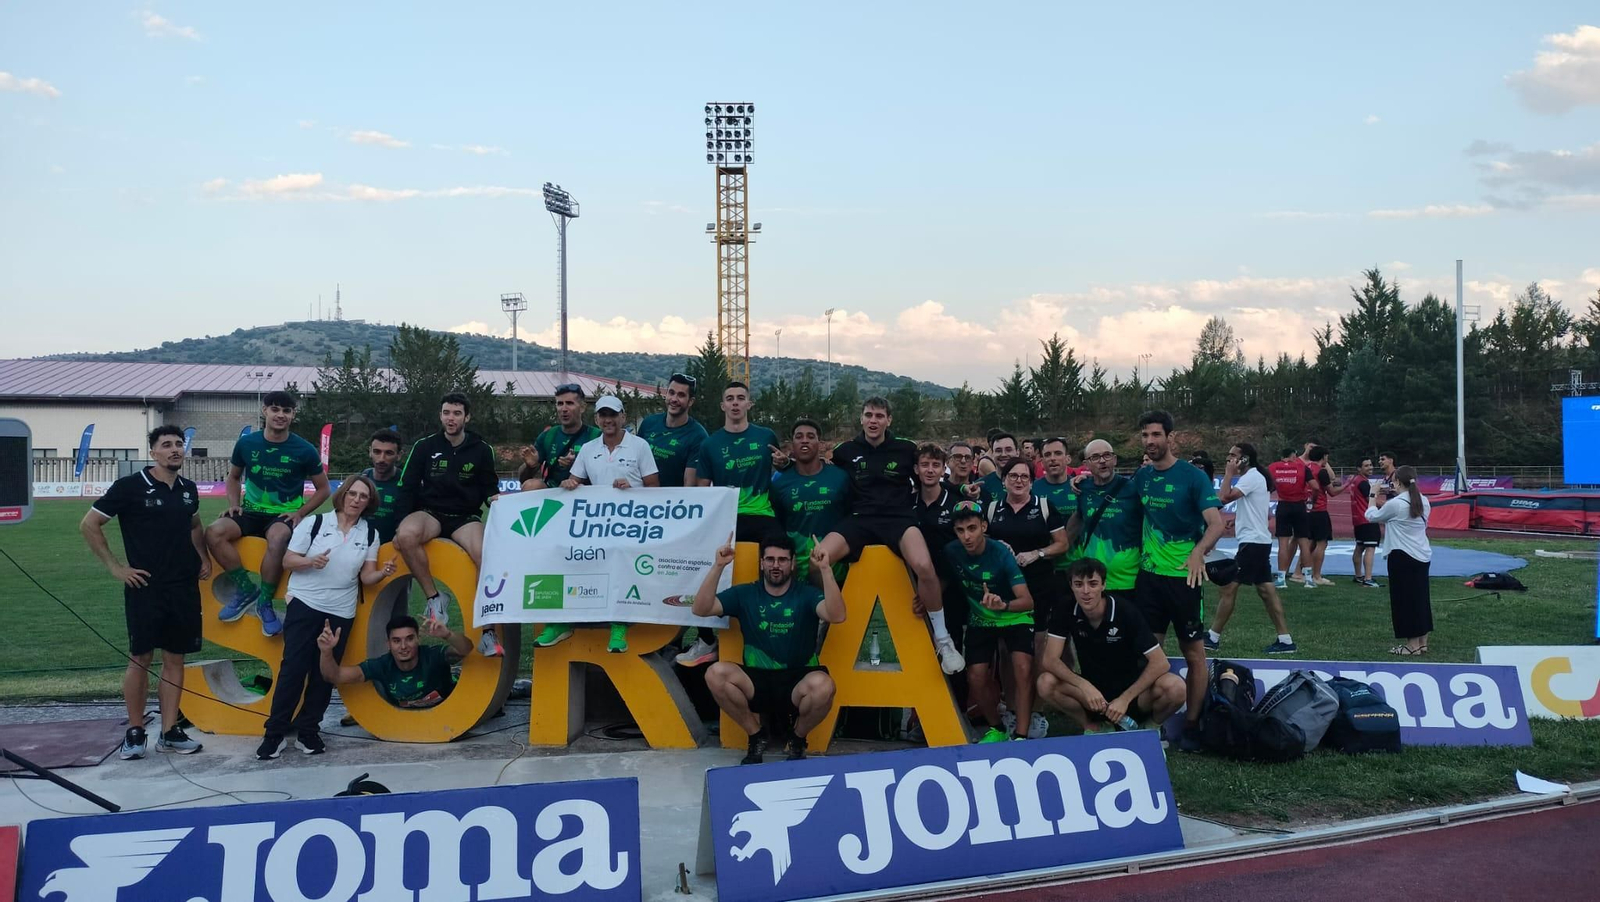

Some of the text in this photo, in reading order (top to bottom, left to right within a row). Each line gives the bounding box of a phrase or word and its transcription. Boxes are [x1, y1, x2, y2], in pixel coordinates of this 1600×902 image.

[571, 498, 704, 520] Fundación
[568, 518, 664, 544] Unicaja
[564, 545, 606, 561] Jaén
[658, 557, 688, 565] asociación
[578, 586, 599, 596] Jaén
[481, 601, 504, 618] jaén
[837, 748, 1168, 875] Joma
